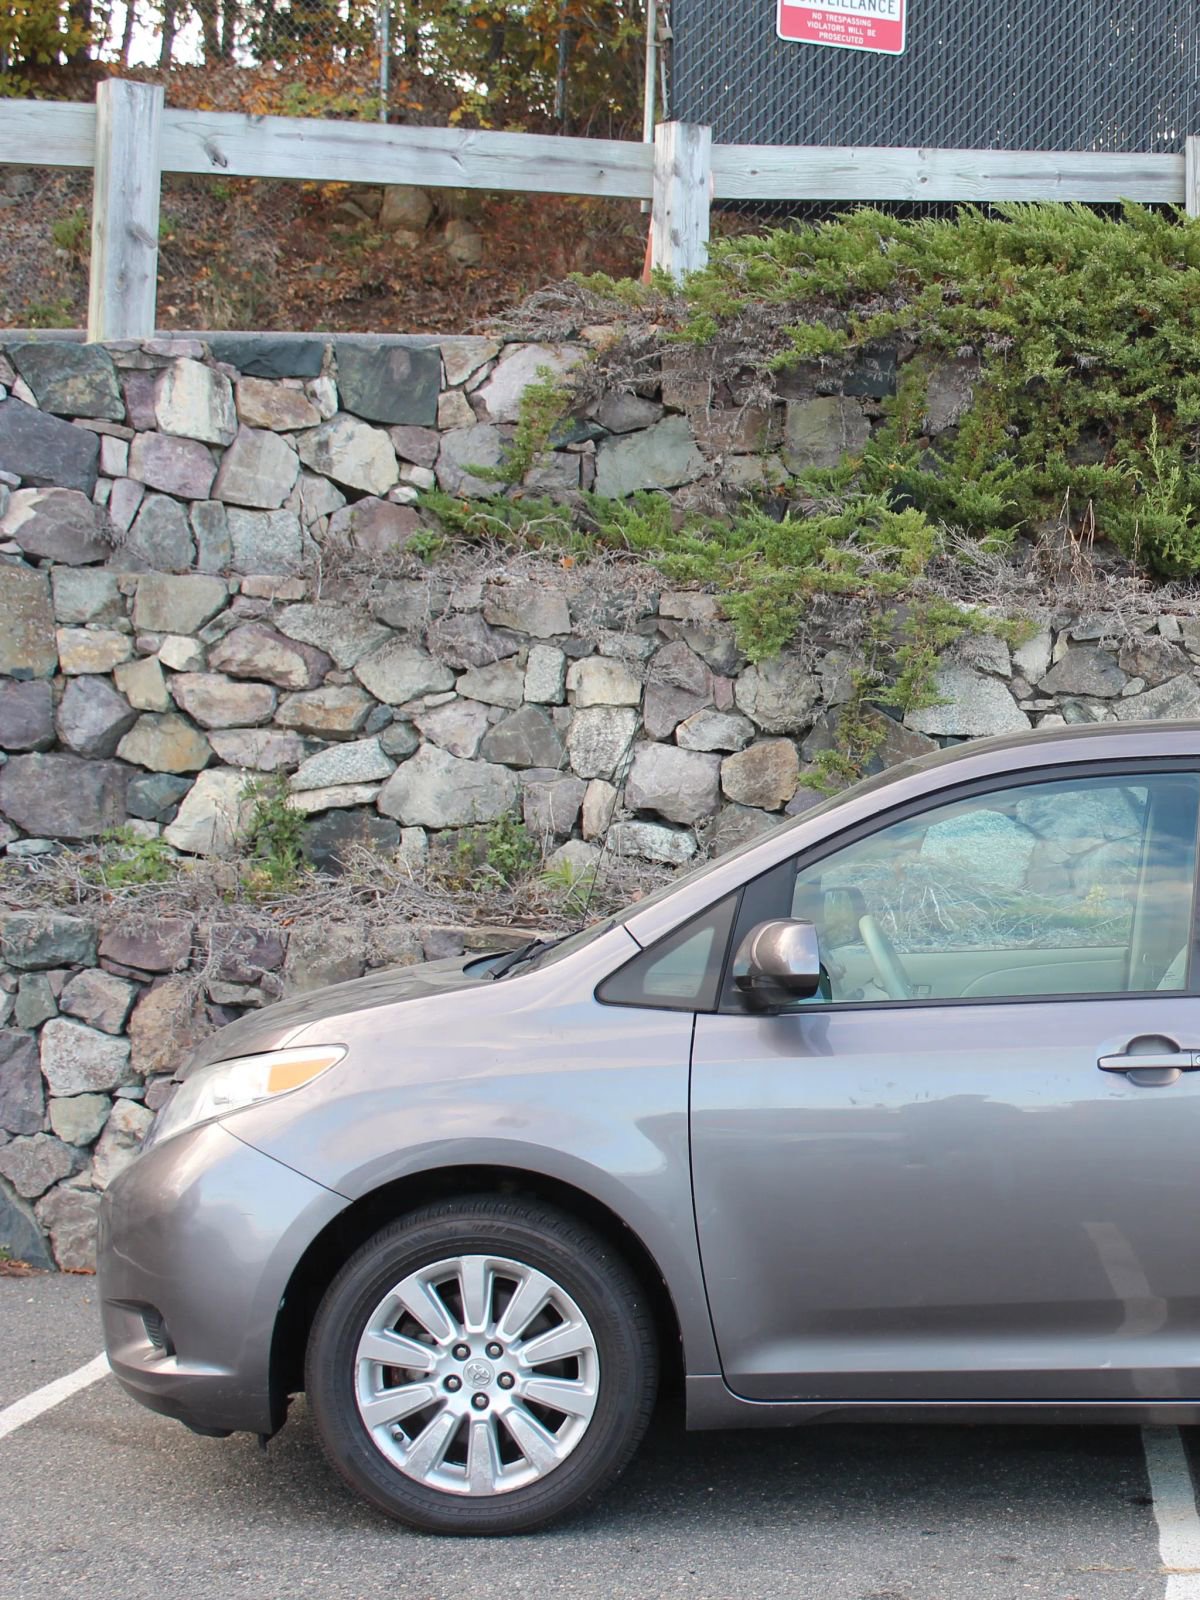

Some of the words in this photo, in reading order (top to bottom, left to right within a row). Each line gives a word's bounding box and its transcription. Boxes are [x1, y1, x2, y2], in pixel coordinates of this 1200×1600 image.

[800, 0, 896, 14] LLANCE
[811, 12, 822, 21] NO
[826, 14, 872, 27] TRESPASSING
[806, 20, 845, 33] VIOLATORS
[848, 26, 864, 35] WILL
[867, 29, 877, 37] BE
[818, 32, 864, 44] PROSECUTED
